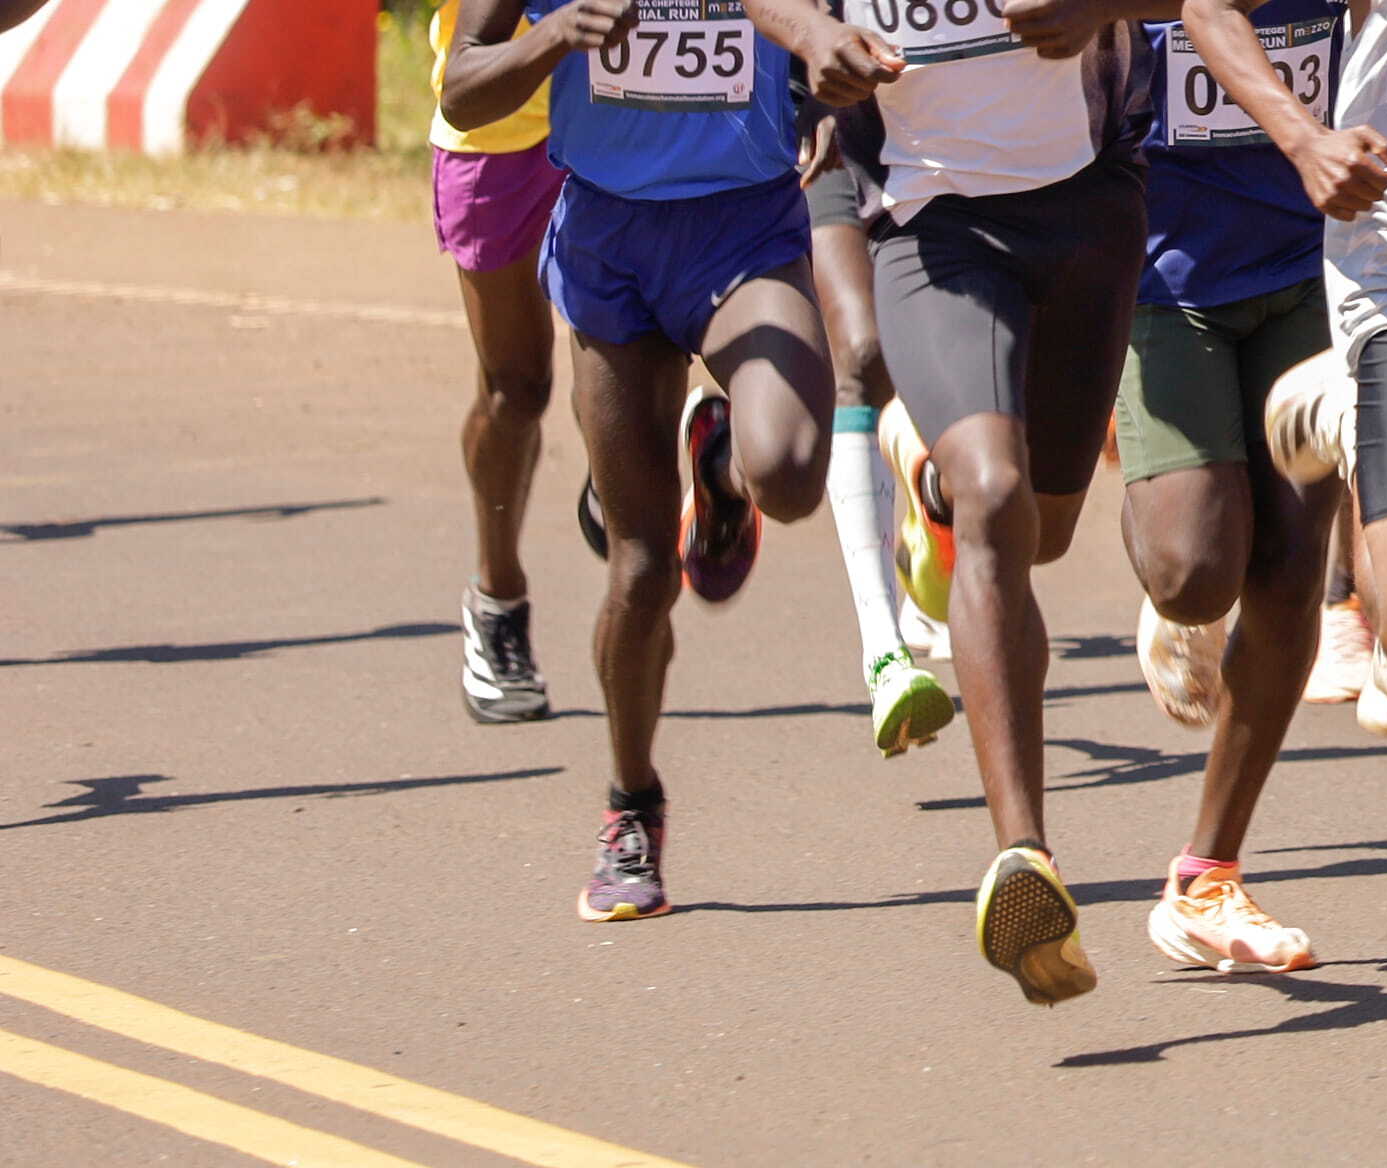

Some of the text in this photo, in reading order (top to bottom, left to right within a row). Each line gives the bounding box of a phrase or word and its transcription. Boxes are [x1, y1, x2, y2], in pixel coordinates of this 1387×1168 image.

[668, 8, 700, 20] RUN
[599, 30, 745, 79] 0755
[1184, 54, 1322, 117] 03
